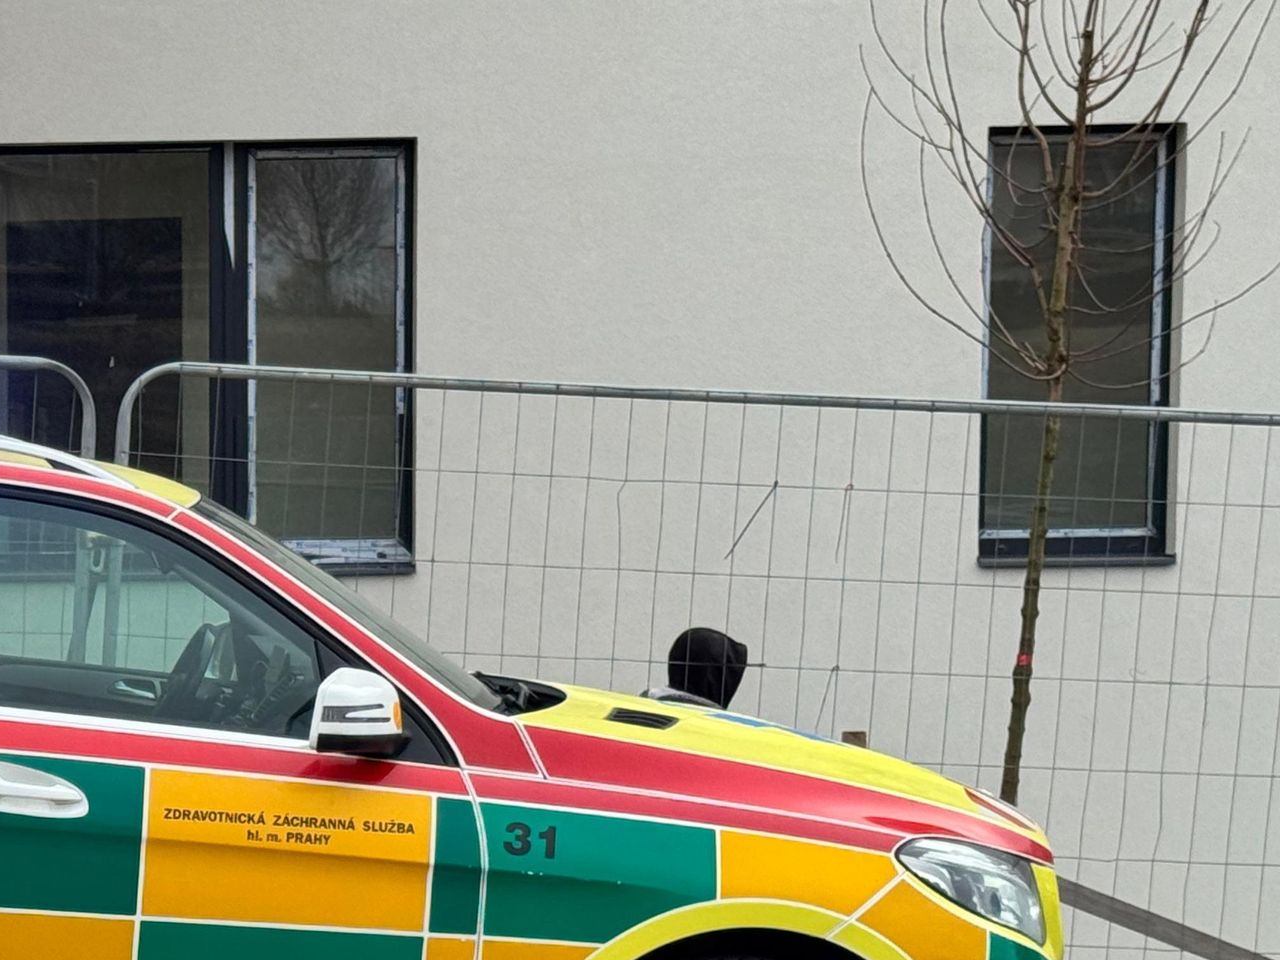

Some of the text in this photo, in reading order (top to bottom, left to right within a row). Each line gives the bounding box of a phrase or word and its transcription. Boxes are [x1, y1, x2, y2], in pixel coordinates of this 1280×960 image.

[163, 808, 416, 835] ZDRAVOTNICKÁ ZÁCHRANNÁ SLUŽBA
[246, 829, 332, 846] hl. m. PRAHY
[503, 822, 556, 859] 31
